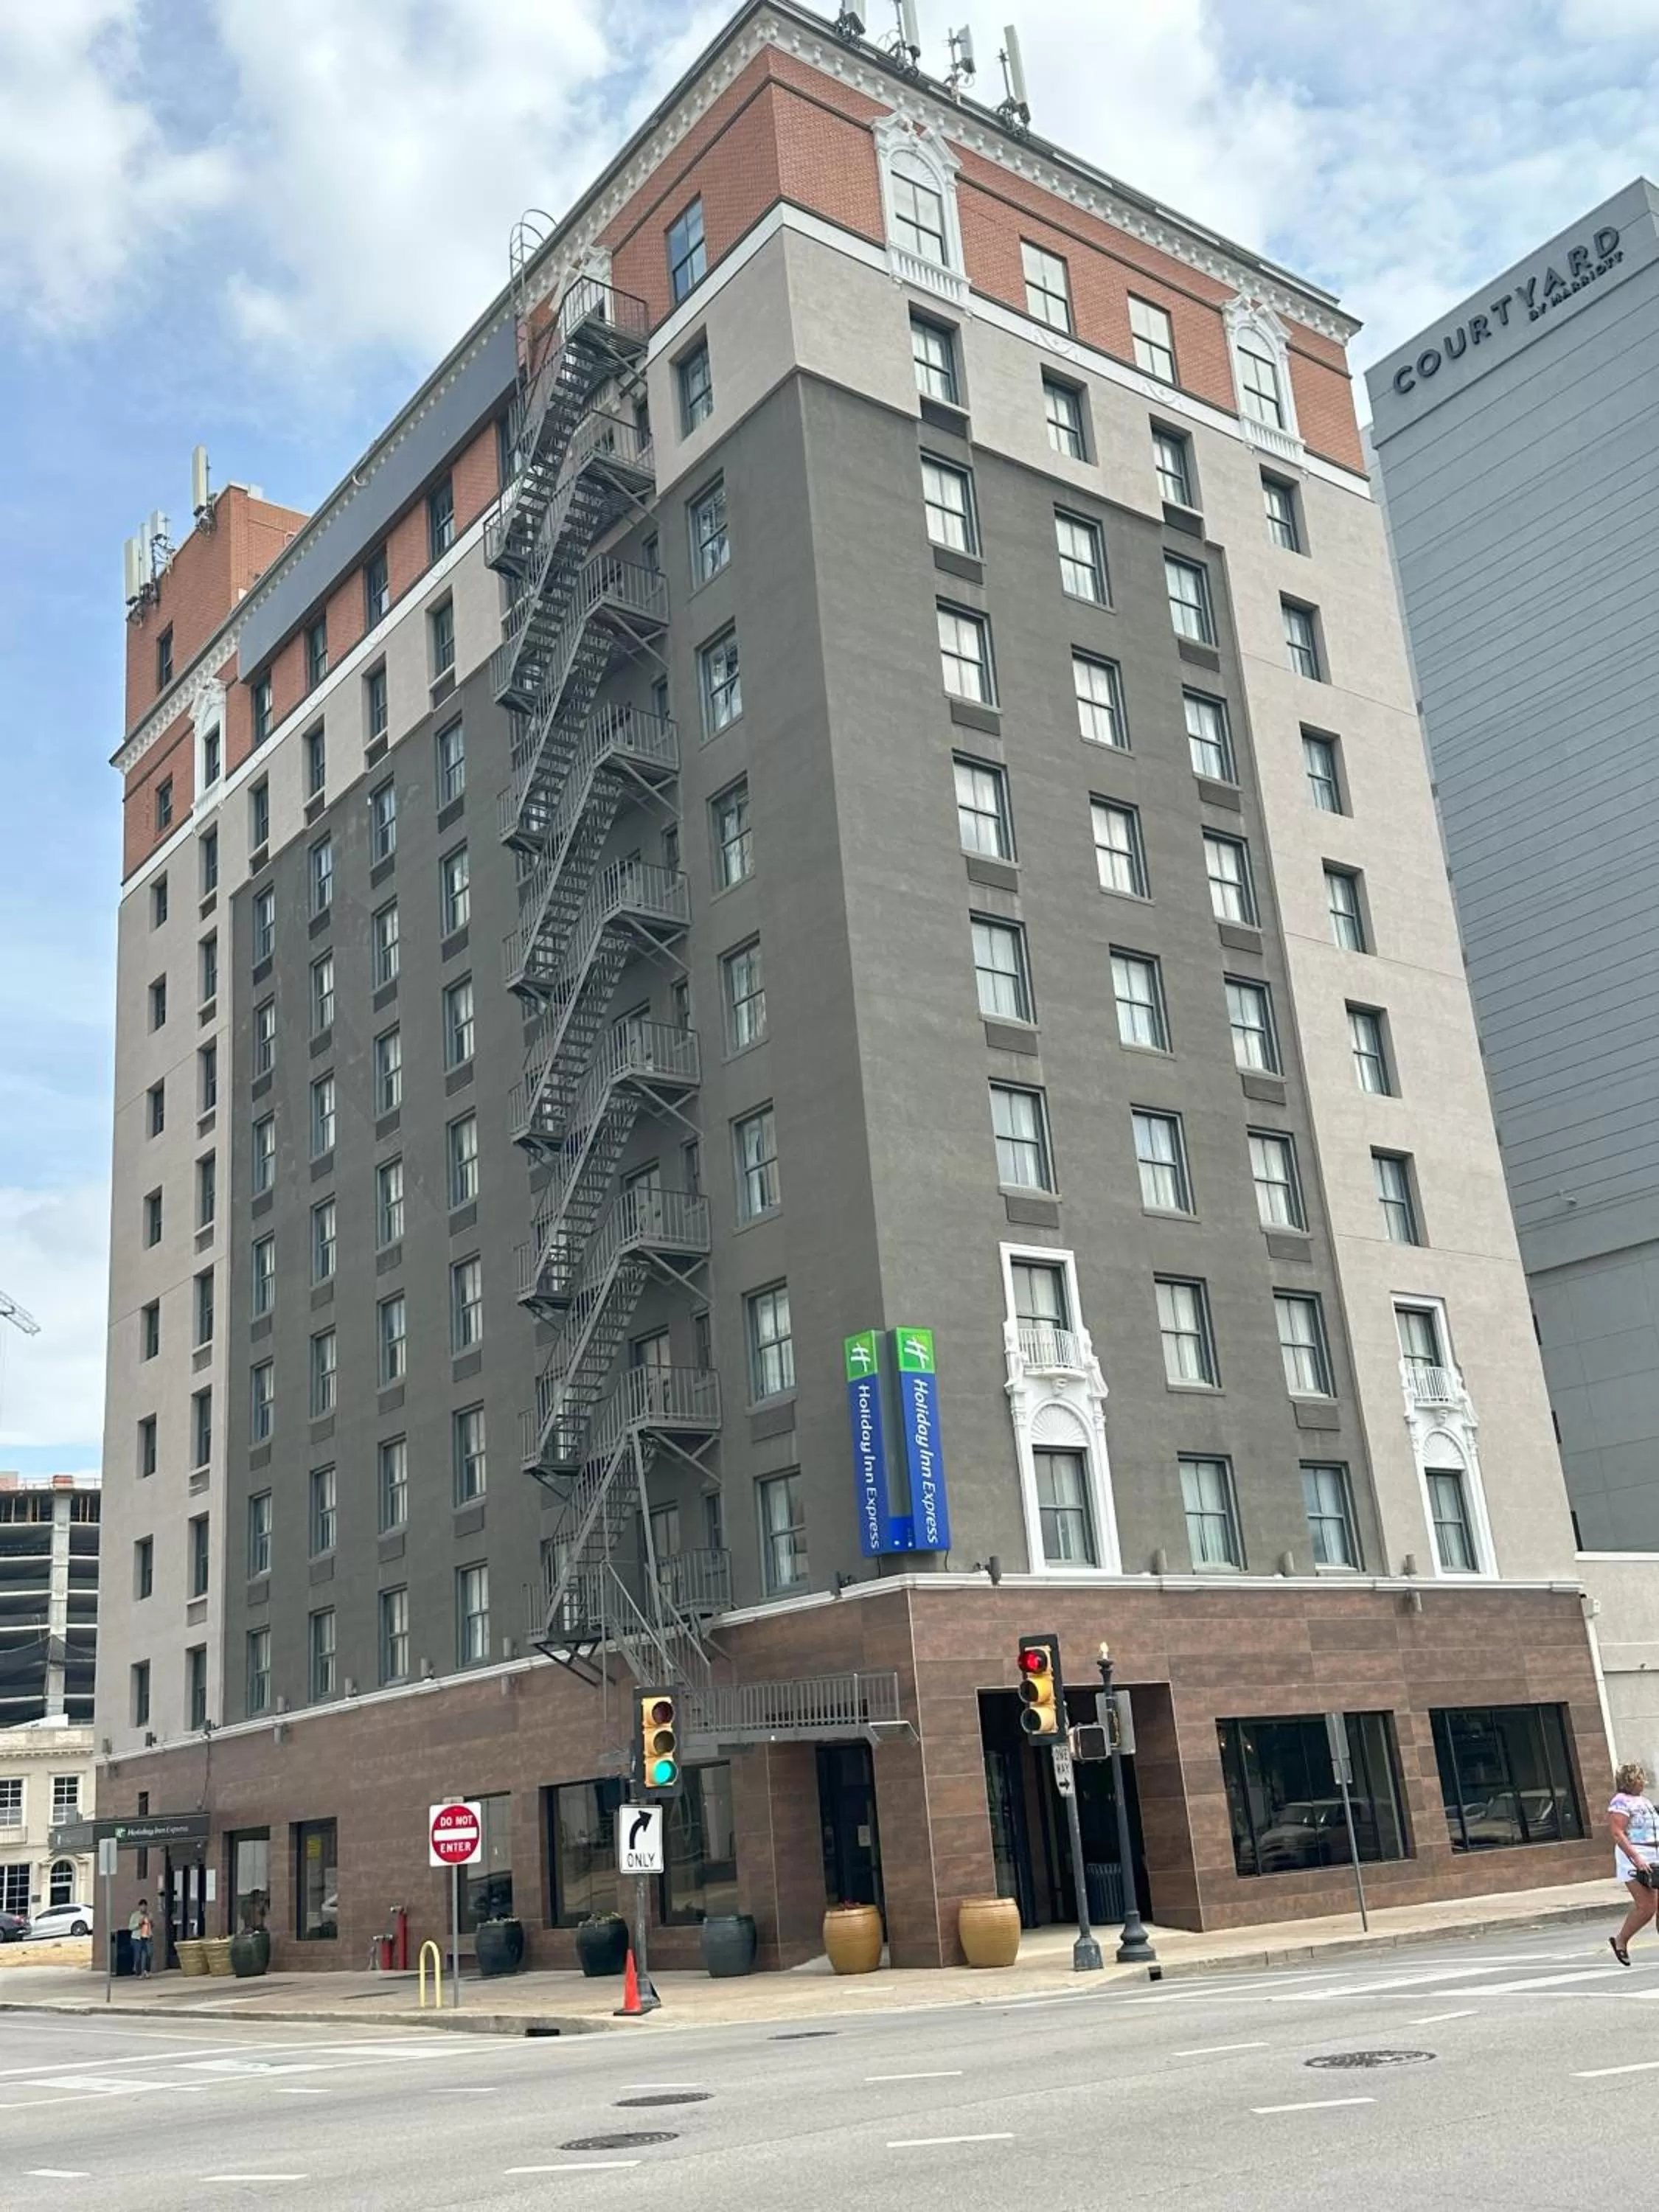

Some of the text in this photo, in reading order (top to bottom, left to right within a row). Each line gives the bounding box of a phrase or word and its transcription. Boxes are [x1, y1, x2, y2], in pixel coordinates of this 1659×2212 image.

[1392, 226, 1619, 395] COURTYARD
[1528, 251, 1624, 321] BY MARRIOTT
[858, 1384, 880, 1549] Holiday Inn Express
[914, 1379, 937, 1544] Holiday Inn Express
[440, 1815, 473, 1826] DO NOT
[440, 1842, 471, 1853] ENTER
[627, 1852, 655, 1867] ONLY
